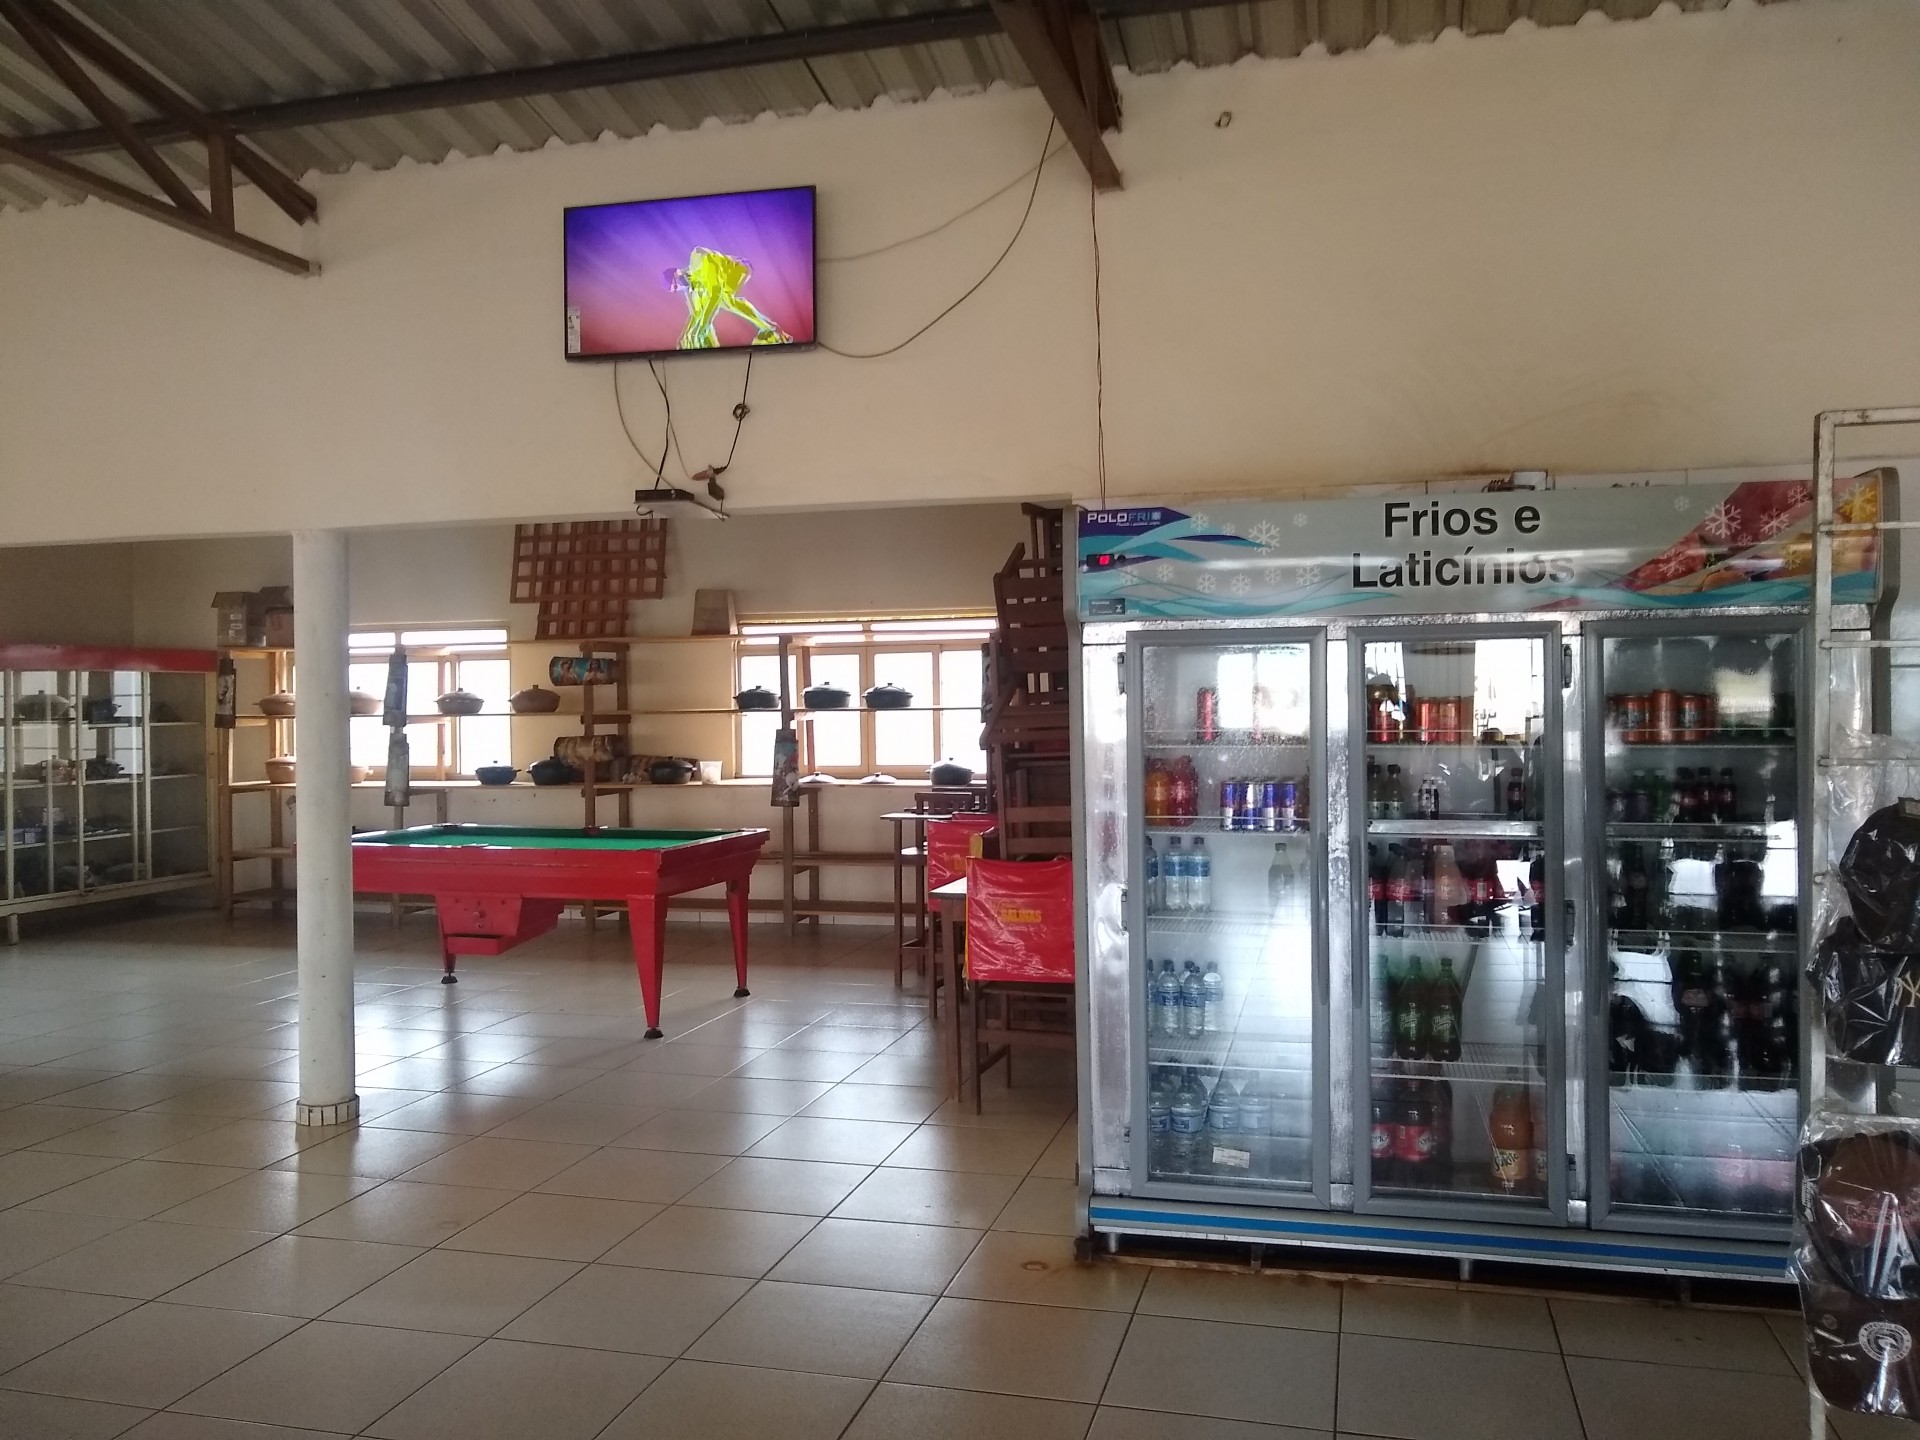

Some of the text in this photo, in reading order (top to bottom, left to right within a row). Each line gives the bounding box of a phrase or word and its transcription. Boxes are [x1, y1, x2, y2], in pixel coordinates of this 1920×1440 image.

[1384, 501, 1540, 537] Frios e
[1352, 546, 1575, 588] Laticínios
